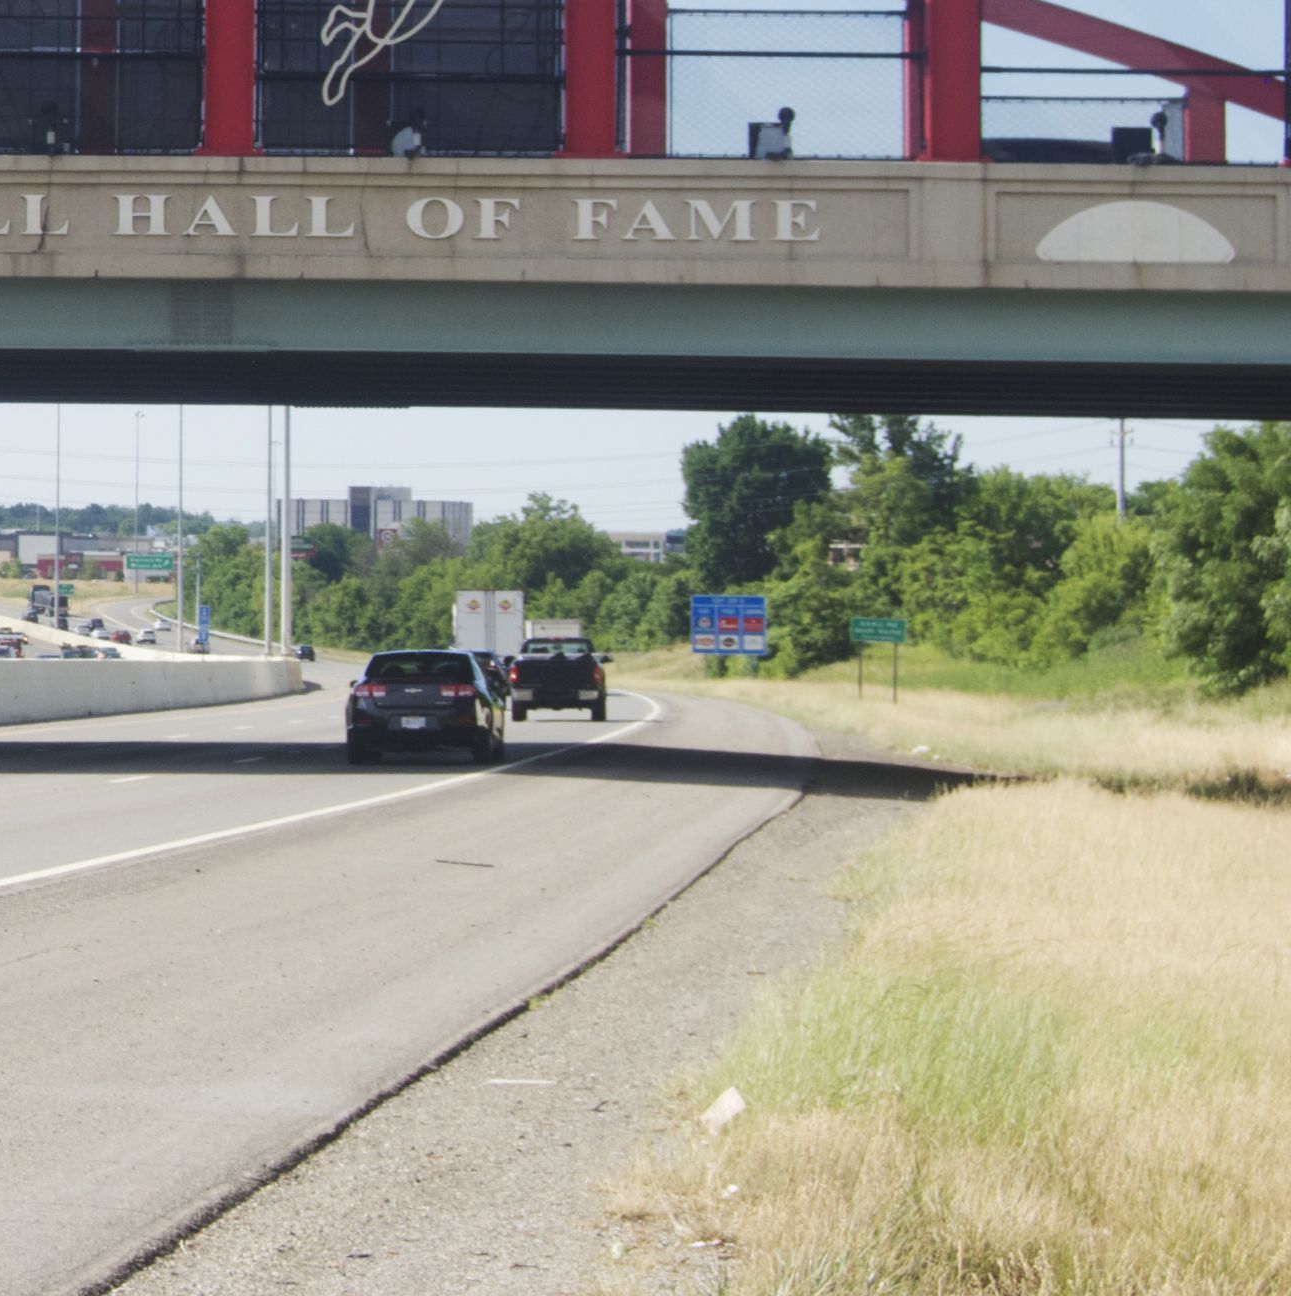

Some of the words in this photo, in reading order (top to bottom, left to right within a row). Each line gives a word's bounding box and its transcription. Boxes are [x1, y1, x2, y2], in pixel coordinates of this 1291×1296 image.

[113, 193, 355, 237] HALL
[405, 196, 521, 240] OF
[572, 198, 821, 242] FAME
